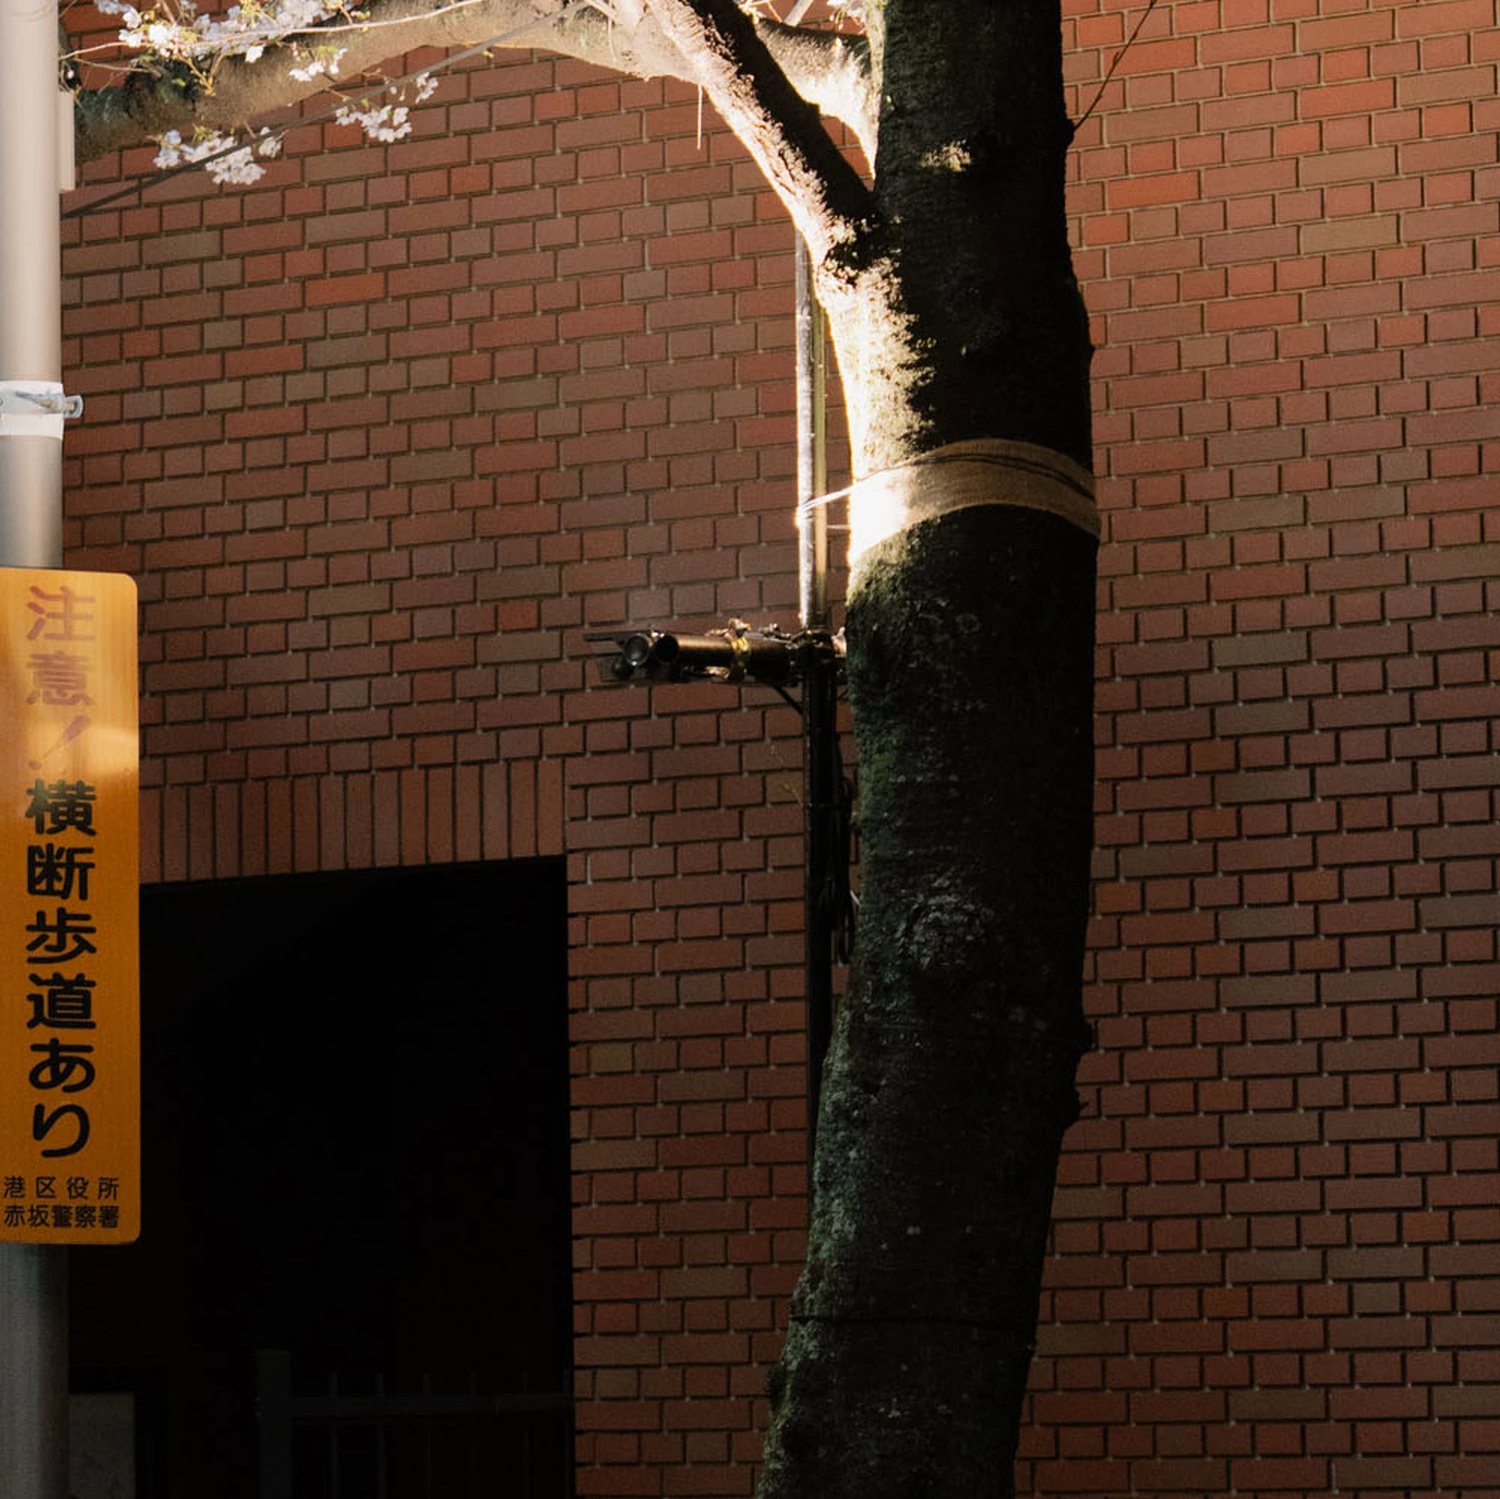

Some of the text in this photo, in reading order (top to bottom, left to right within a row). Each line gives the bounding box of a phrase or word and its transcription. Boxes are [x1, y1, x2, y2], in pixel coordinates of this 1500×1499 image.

[25, 779, 97, 1158] 横断歩道あり
[3, 1175, 120, 1200] 港区役所
[3, 1204, 120, 1228] 赤坂警察署
